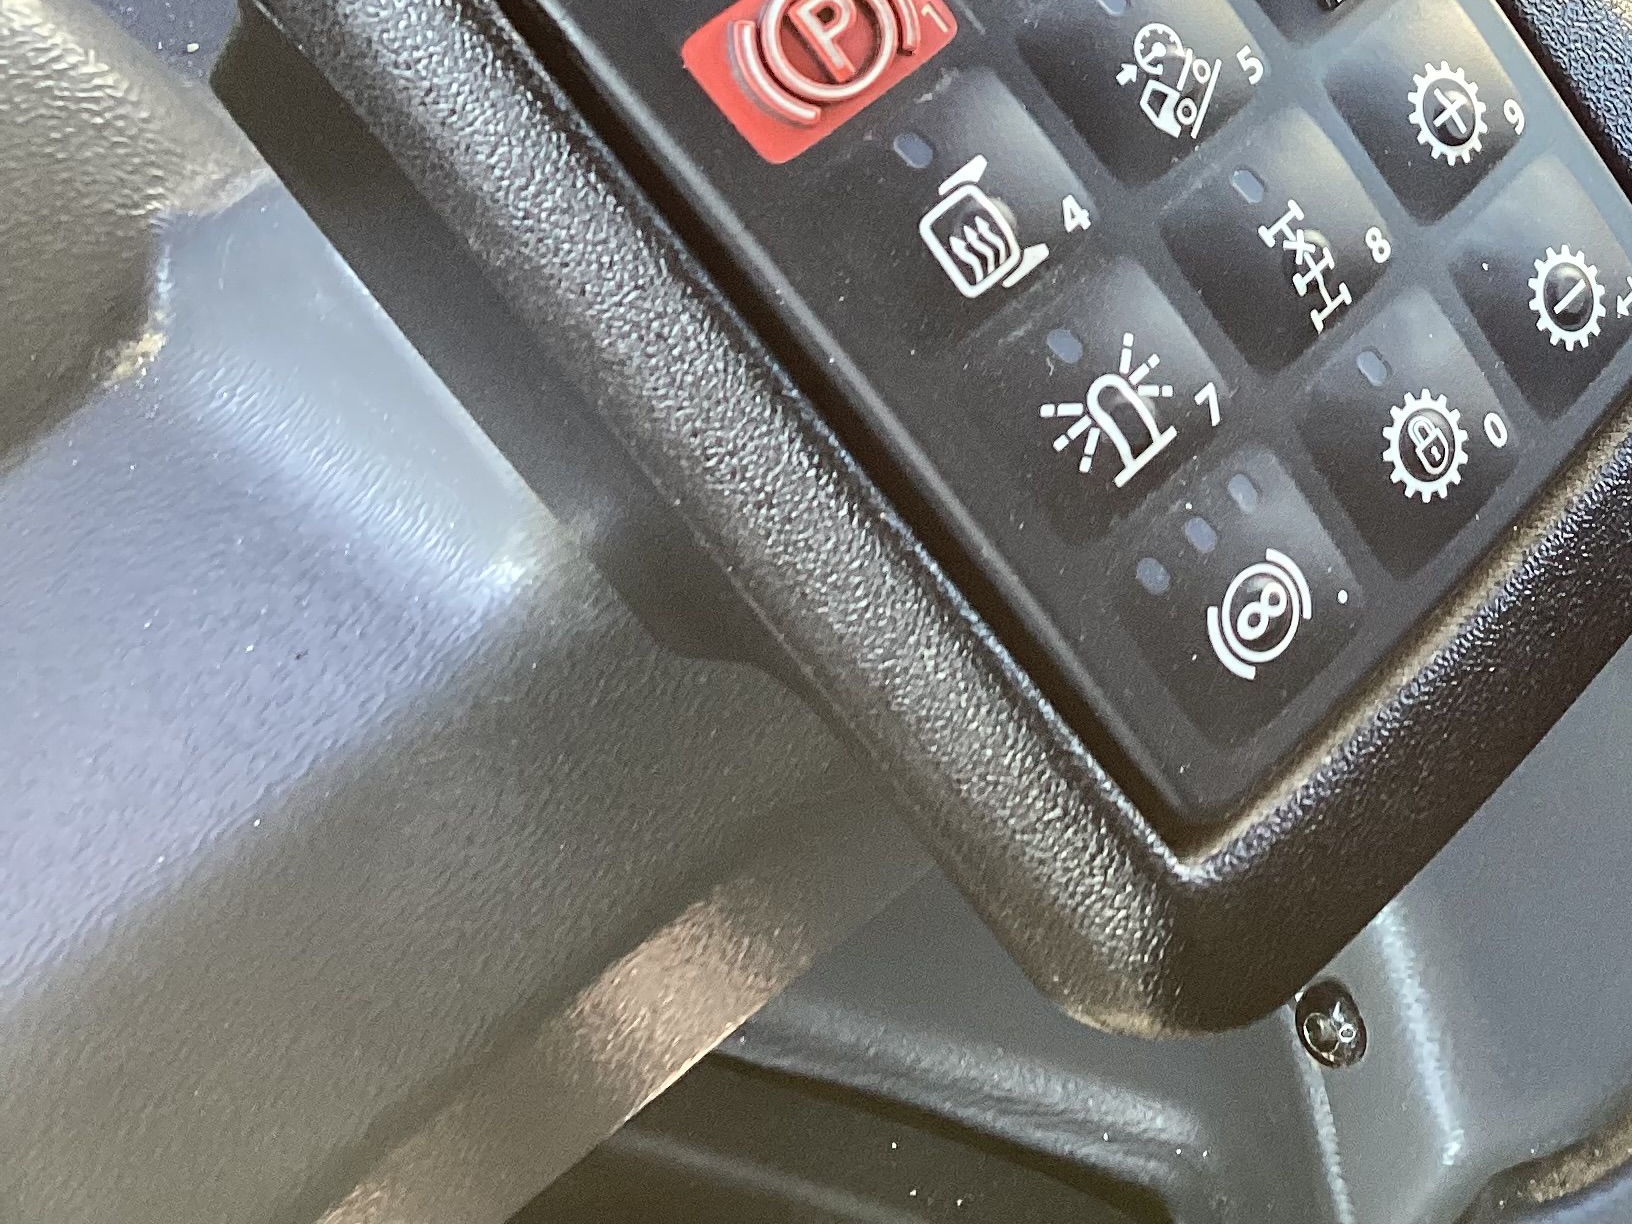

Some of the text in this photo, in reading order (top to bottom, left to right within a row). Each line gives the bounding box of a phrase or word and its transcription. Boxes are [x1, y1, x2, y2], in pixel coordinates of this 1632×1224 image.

[922, 4, 949, 32] 1
[1236, 45, 1264, 85] 5
[1502, 99, 1526, 135] 9
[1062, 195, 1091, 232] 4
[1365, 227, 1392, 264] 8
[1194, 382, 1221, 427] 7
[1483, 412, 1510, 448] 0
